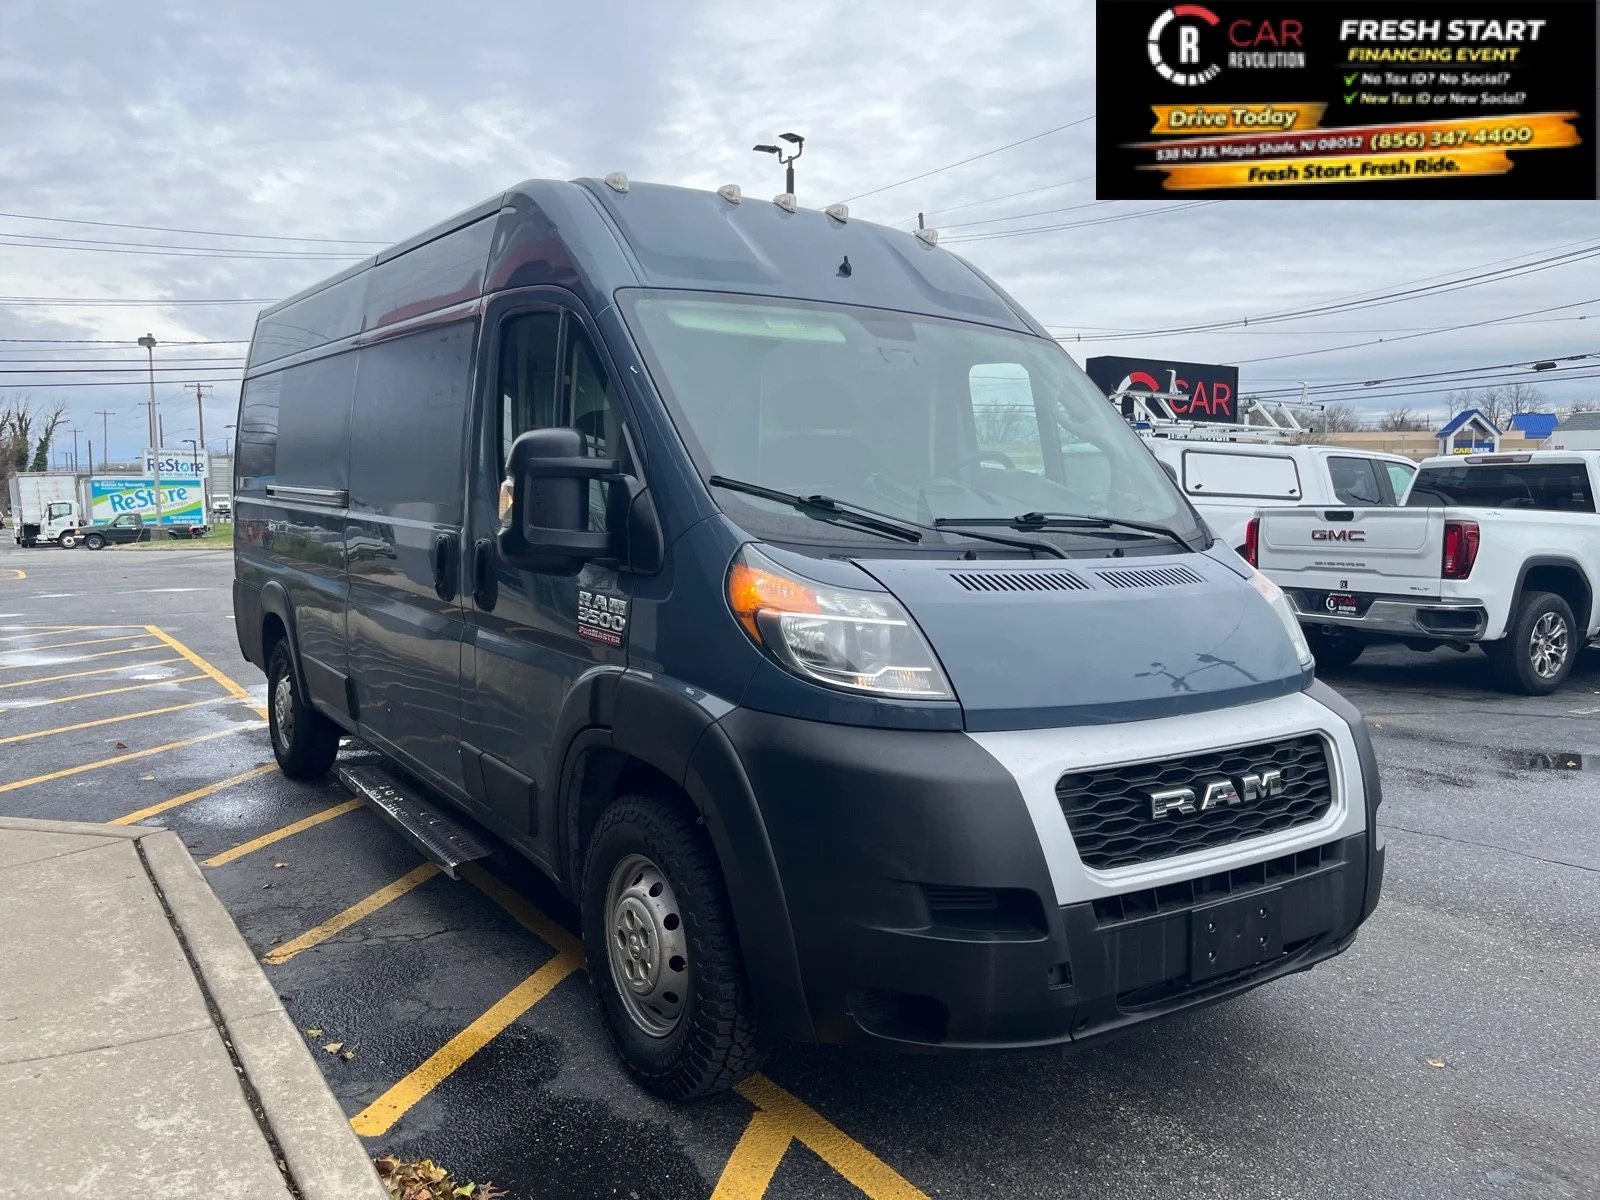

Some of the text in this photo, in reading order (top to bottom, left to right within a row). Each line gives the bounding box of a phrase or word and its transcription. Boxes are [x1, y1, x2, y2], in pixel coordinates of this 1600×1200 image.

[1169, 379, 1231, 416] CAR
[147, 458, 205, 472] ReStore
[108, 487, 188, 513] ReStore
[1312, 530, 1366, 542] GMC
[579, 591, 627, 615] RAM
[578, 606, 626, 631] 3500
[1151, 769, 1281, 820] RAM
